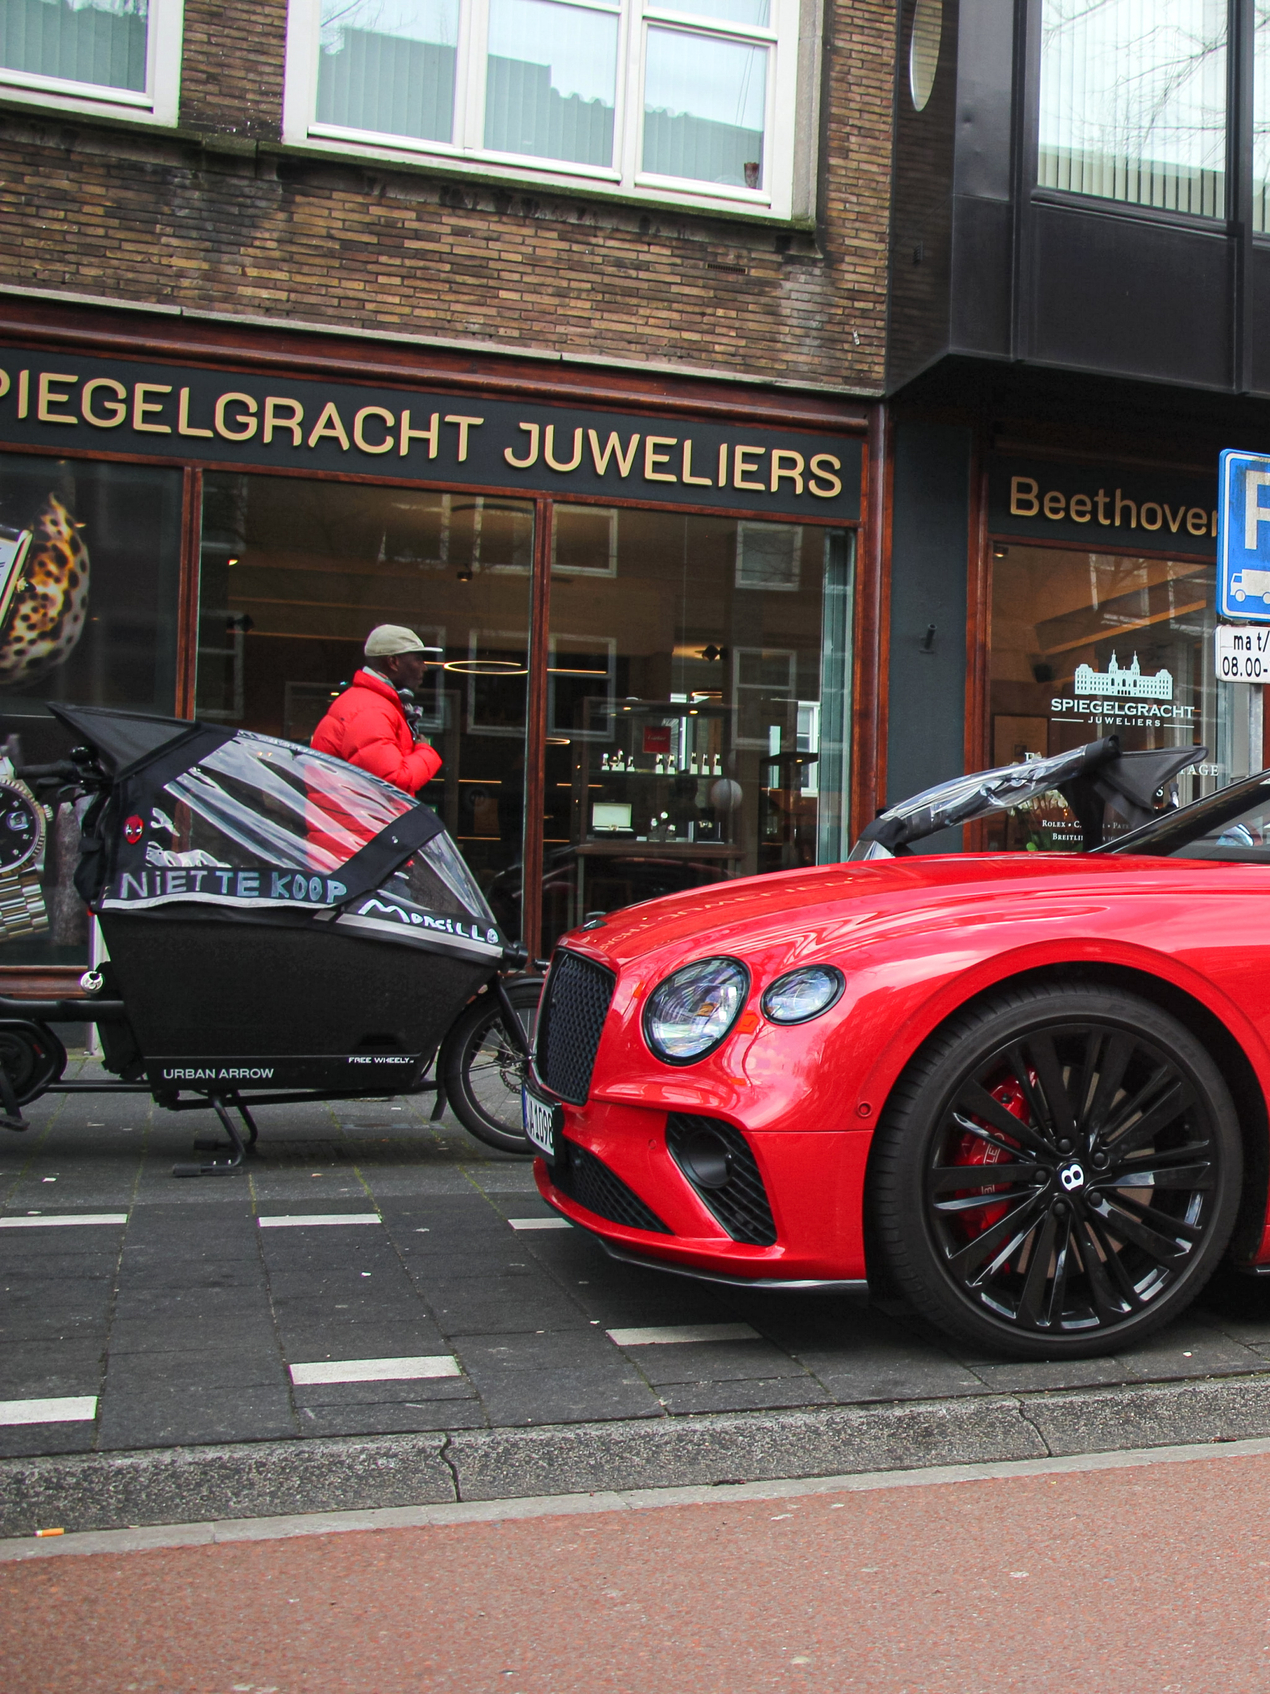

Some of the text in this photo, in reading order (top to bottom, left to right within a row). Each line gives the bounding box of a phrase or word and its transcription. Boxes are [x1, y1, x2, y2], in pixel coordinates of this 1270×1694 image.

[503, 421, 842, 498] JUWELIERS
[1233, 634, 1252, 651] ma
[1051, 698, 1195, 719] SPIEGELGRACHT
[1088, 716, 1161, 727] JUWELIERS
[215, 871, 260, 897] TE
[271, 872, 347, 904] KOOP
[348, 1056, 372, 1064] FREE
[163, 1067, 275, 1079] URBAN ARROW
